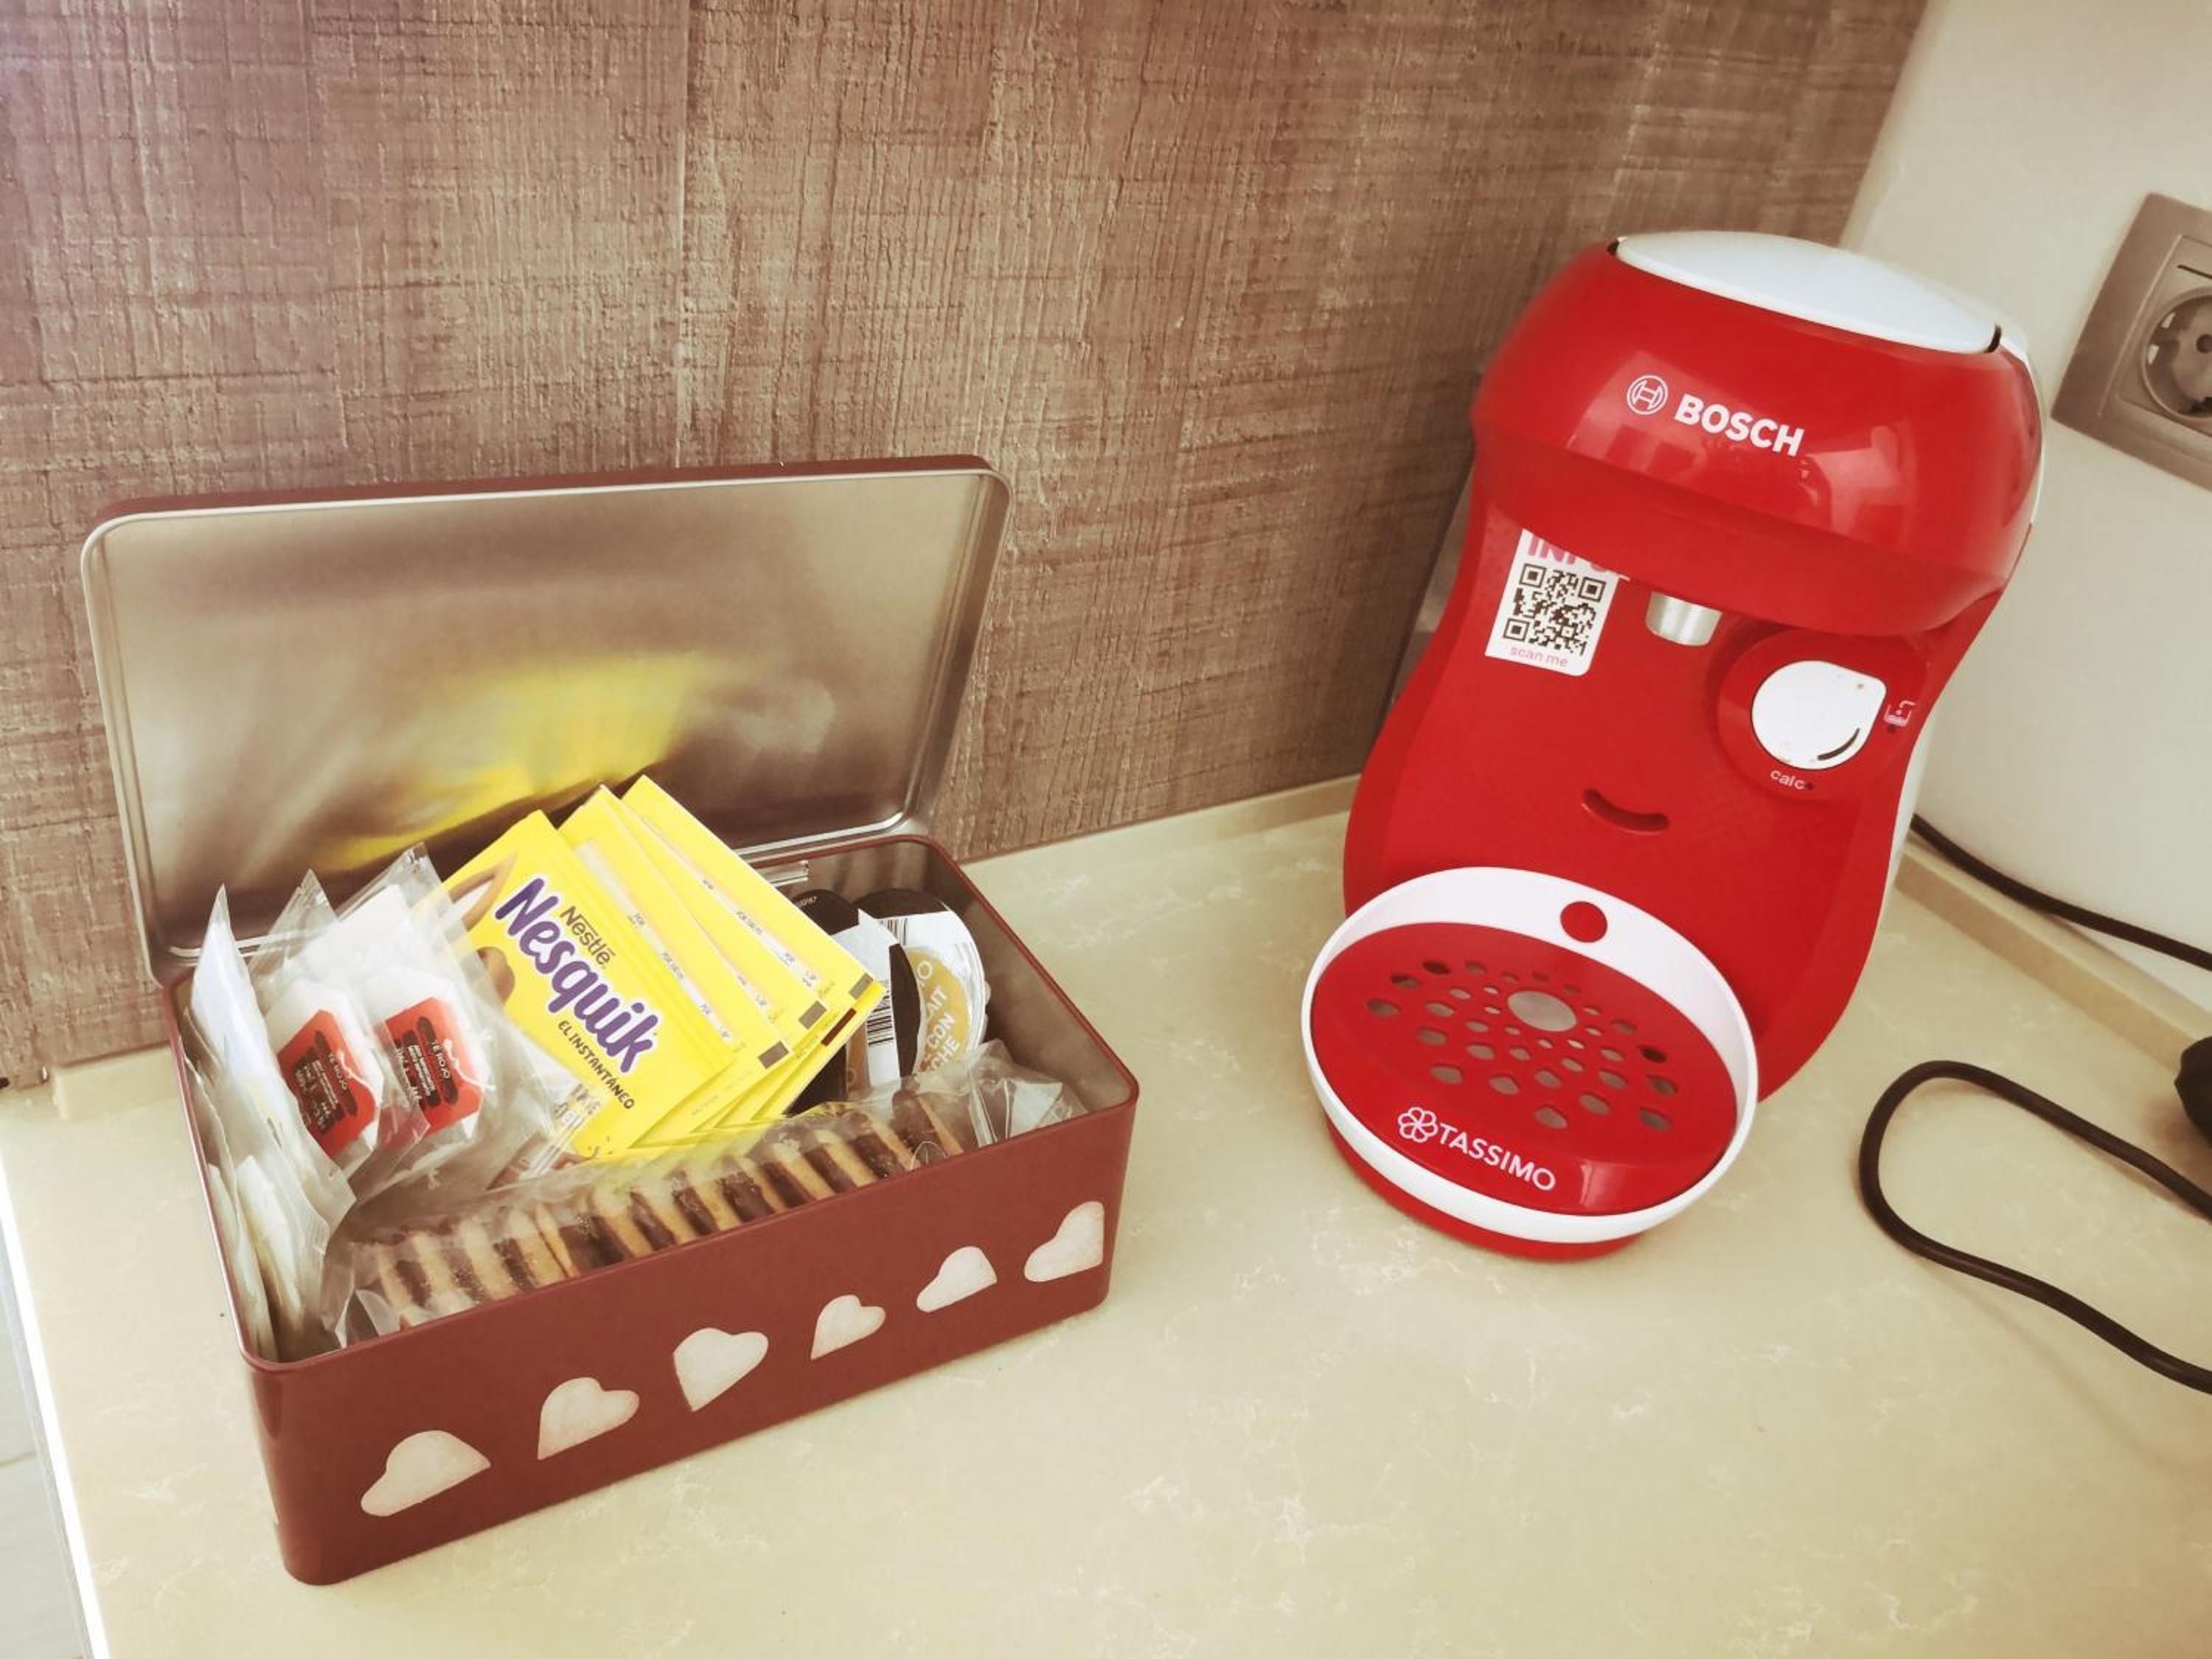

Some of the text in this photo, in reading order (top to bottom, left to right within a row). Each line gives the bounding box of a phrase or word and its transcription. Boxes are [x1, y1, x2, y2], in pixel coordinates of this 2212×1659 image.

[1674, 393, 1804, 456] BOSCH
[1511, 647, 1568, 668] scan me
[1770, 770, 1805, 790] calc
[495, 877, 658, 1074] Nesquik
[558, 1020, 573, 1036] EL
[1439, 1122, 1556, 1191] TASSIMO
